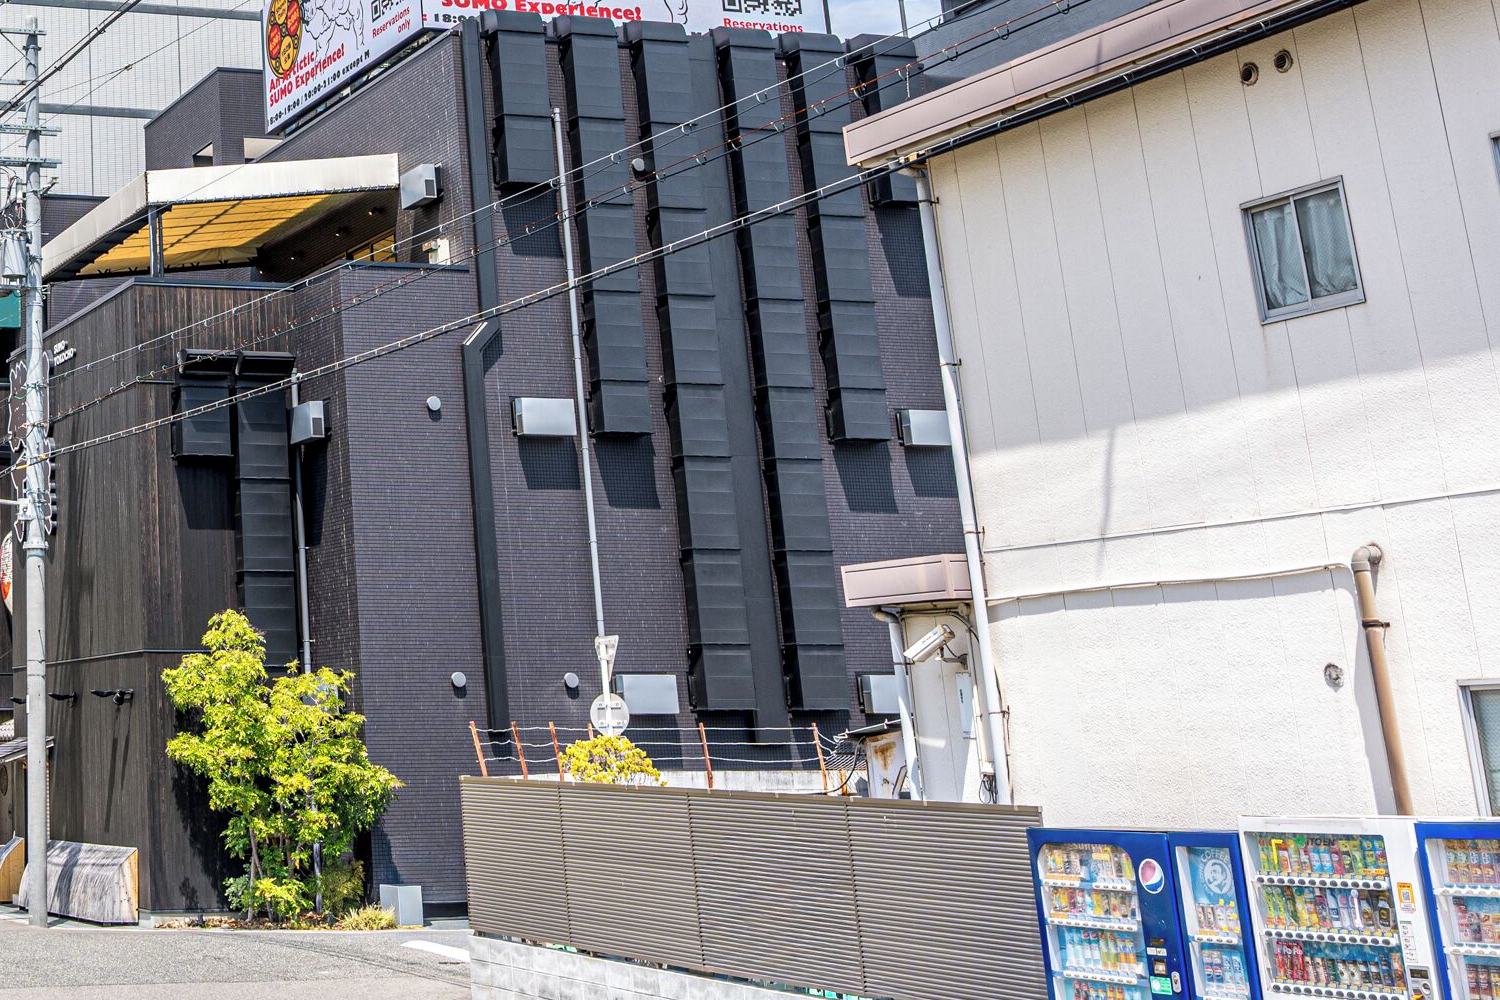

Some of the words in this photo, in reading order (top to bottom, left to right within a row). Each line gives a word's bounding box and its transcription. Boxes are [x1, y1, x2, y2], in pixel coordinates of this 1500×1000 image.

[372, 6, 410, 38] Reservations
[397, 18, 411, 34] only
[723, 18, 804, 33] Reservations
[342, 56, 363, 75] except
[269, 82, 293, 107] SUMO
[295, 43, 345, 90] Experience!
[269, 78, 280, 93] An
[1201, 849, 1230, 863] COFFEE
